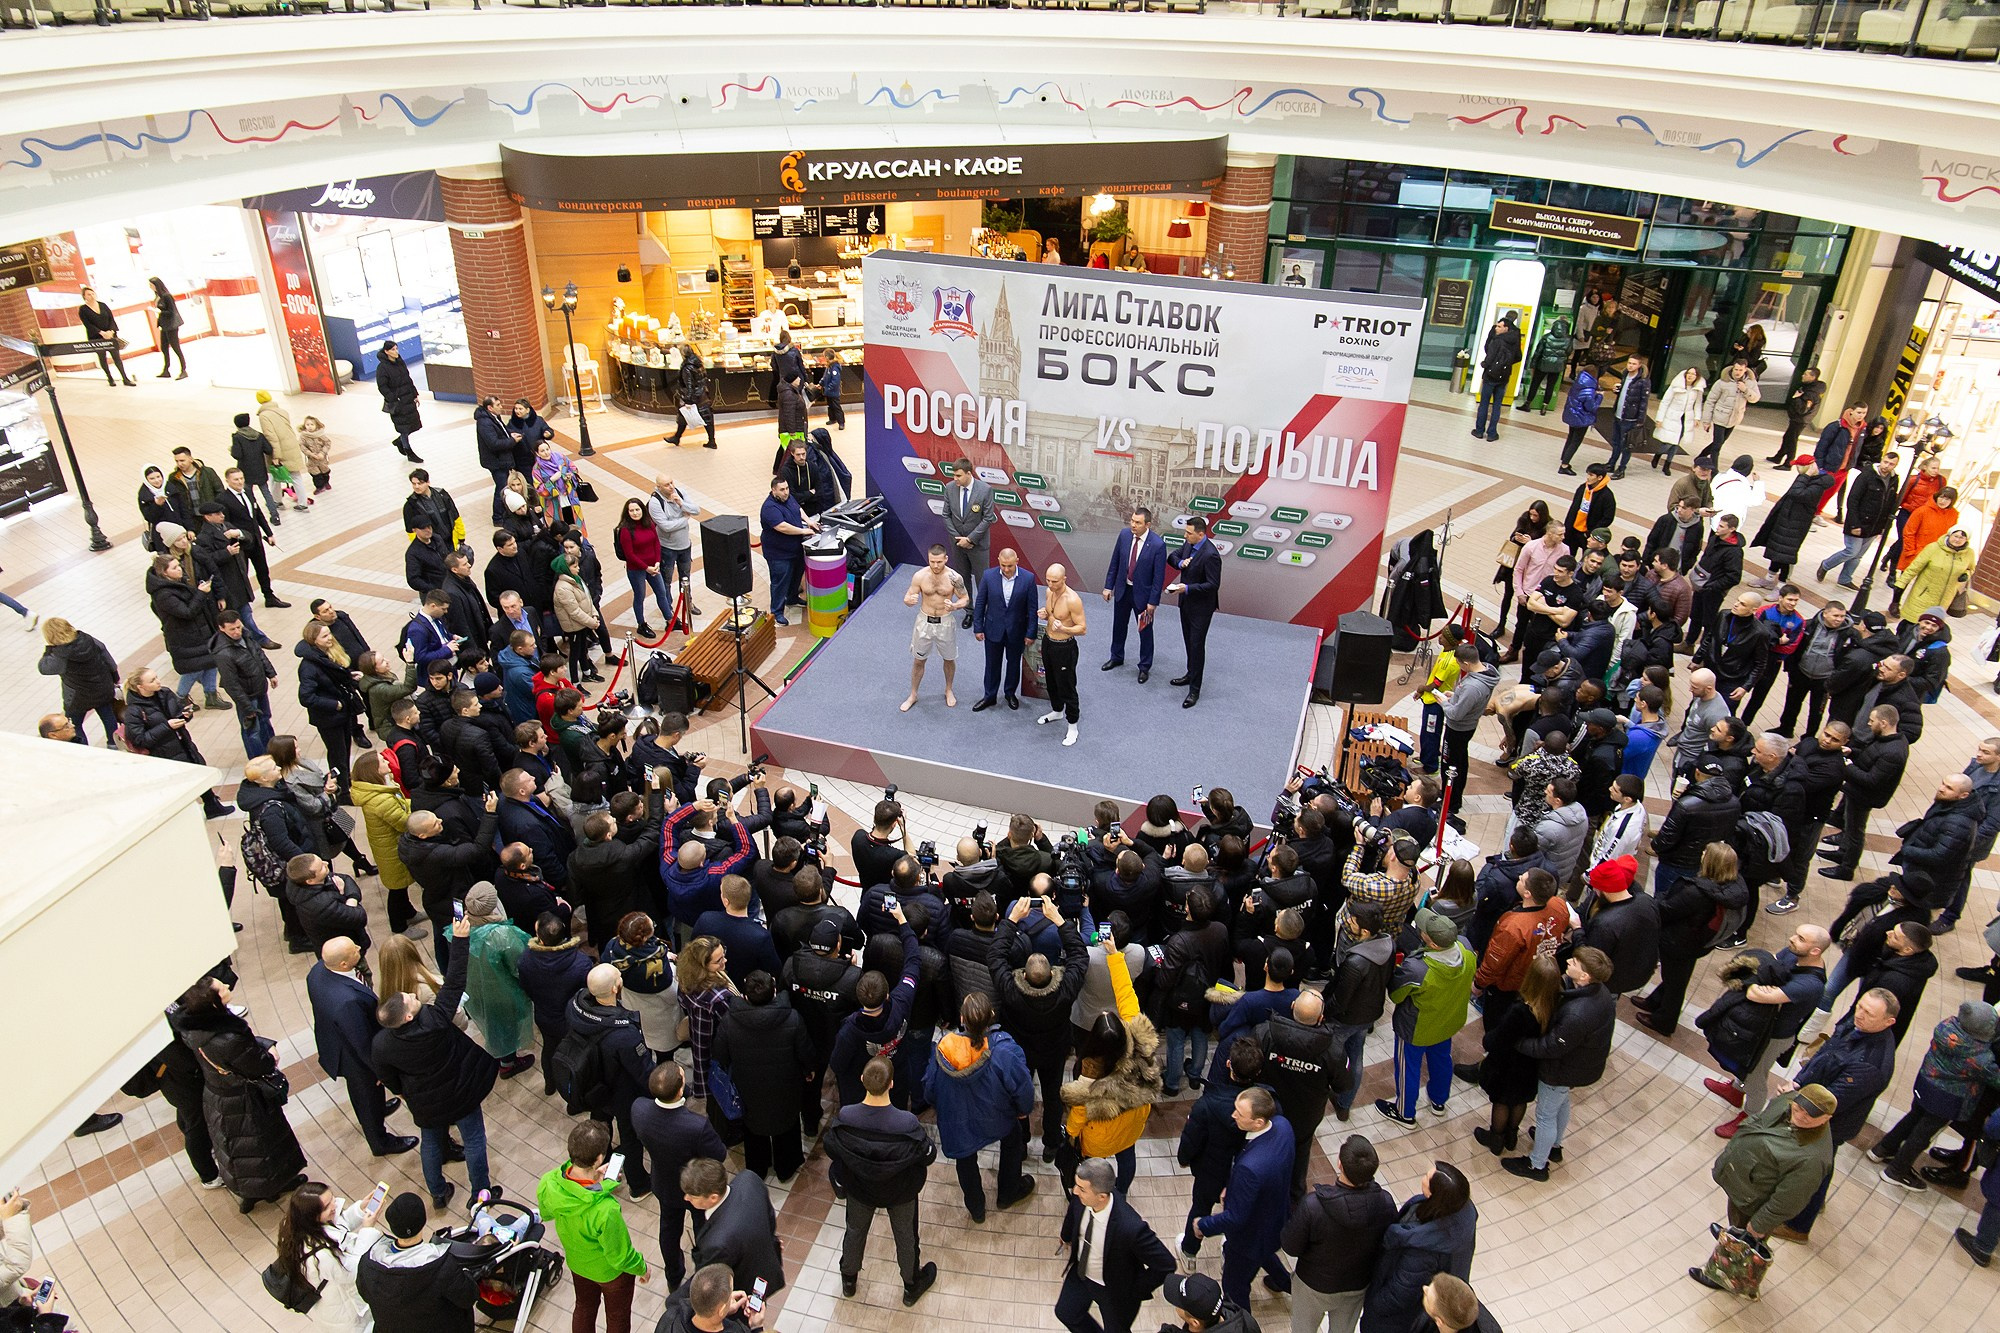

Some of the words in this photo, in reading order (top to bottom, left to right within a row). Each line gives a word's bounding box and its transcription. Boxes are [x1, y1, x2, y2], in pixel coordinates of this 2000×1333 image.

[785, 86, 841, 97] МОСКВА
[1121, 88, 1175, 101] МОСКВА
[1274, 99, 1317, 114] МОСКВА
[807, 158, 941, 181] КРУАССАН
[954, 156, 1023, 176] КАФЕ
[936, 187, 1000, 200] boulangerie
[1039, 185, 1065, 197] кафе
[1101, 182, 1172, 194] кондитерская
[687, 197, 736, 208] пекарня
[779, 194, 802, 204] café
[843, 191, 898, 204] pâtisserie
[557, 201, 643, 213] кондитерская
[1535, 212, 1561, 223] ВЫХОД
[1562, 216, 1568, 224] К
[1569, 217, 1595, 227] СКВЕРУ
[1506, 216, 1512, 224] С
[1512, 217, 1565, 231] МОНУМЕНТОМ
[1565, 226, 1588, 235] «МАТЬ
[1588, 228, 1622, 240] РОССИЯ»
[286, 272, 301, 291] ДО
[885, 324, 917, 332] ФЕДЕРАЦИЯ
[899, 331, 921, 339] РОССИИ
[1039, 324, 1220, 358] ПРОФЕССИОНАЛЬНЫЙ
[1339, 336, 1380, 348] BOXING
[1322, 350, 1371, 360] ИНФОРМАЦИОННЫЙ
[1037, 347, 1216, 397] БОКС
[1337, 365, 1375, 377] ЕВРОПА
[1885, 326, 1927, 416] SALE
[883, 383, 1028, 448] РОССИЯ
[1098, 415, 1137, 453] VS
[1196, 421, 1379, 491] ПОЛЬША
